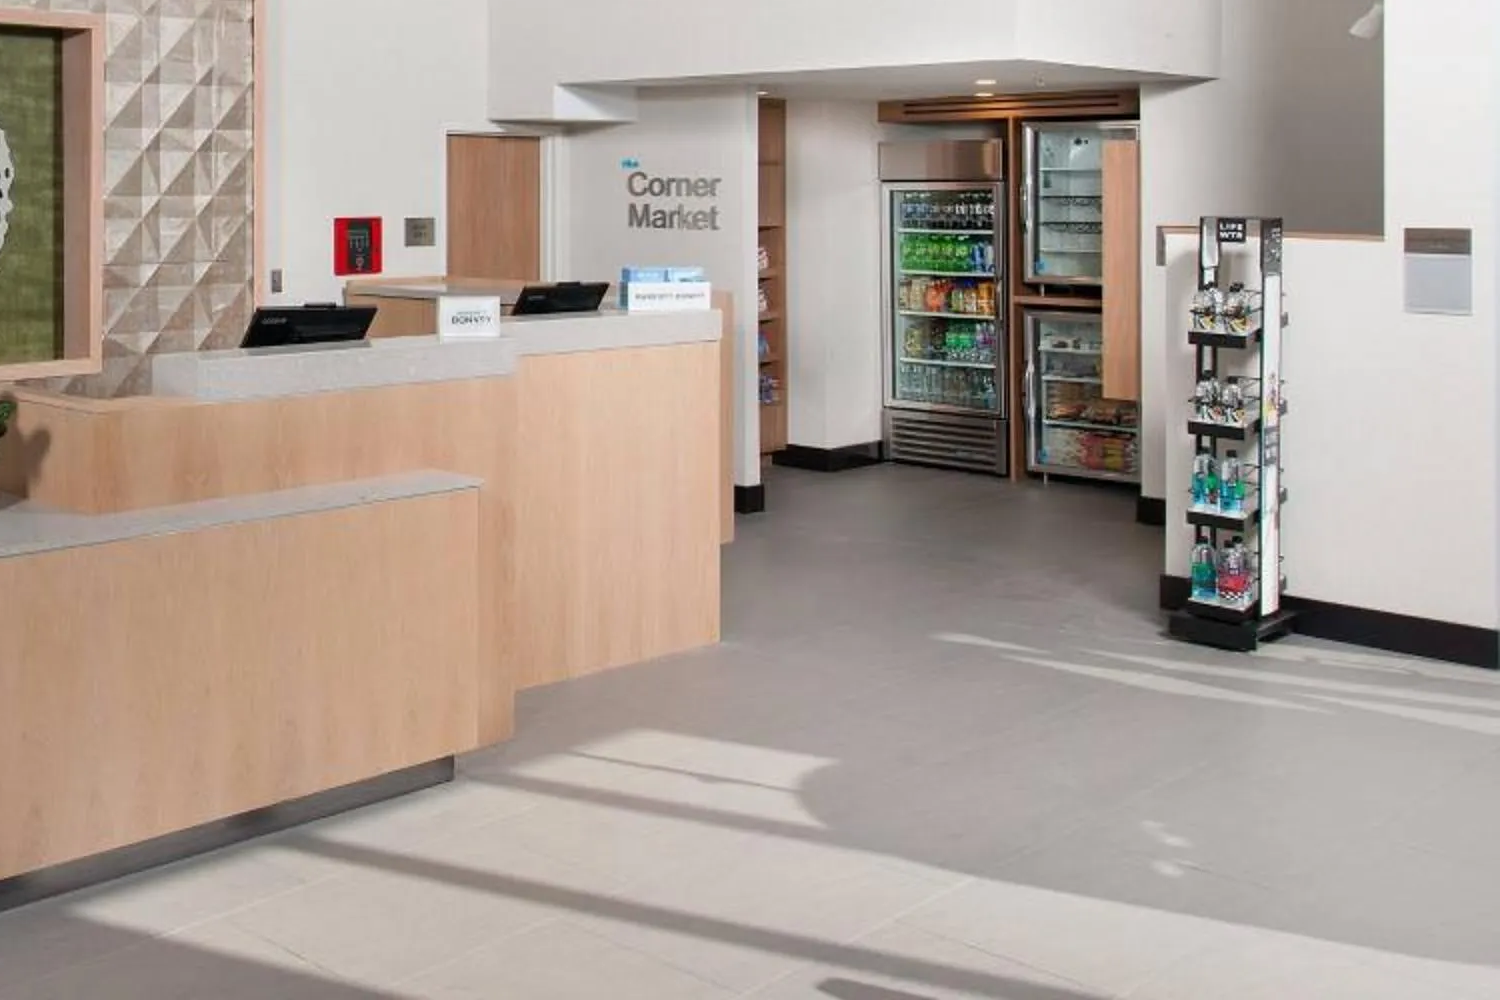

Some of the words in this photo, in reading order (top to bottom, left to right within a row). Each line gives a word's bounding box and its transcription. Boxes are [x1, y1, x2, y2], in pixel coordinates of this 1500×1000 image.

[627, 171, 722, 197] Corner
[627, 203, 721, 231] Market
[1219, 223, 1243, 231] LIFE
[1219, 231, 1243, 239] WTR
